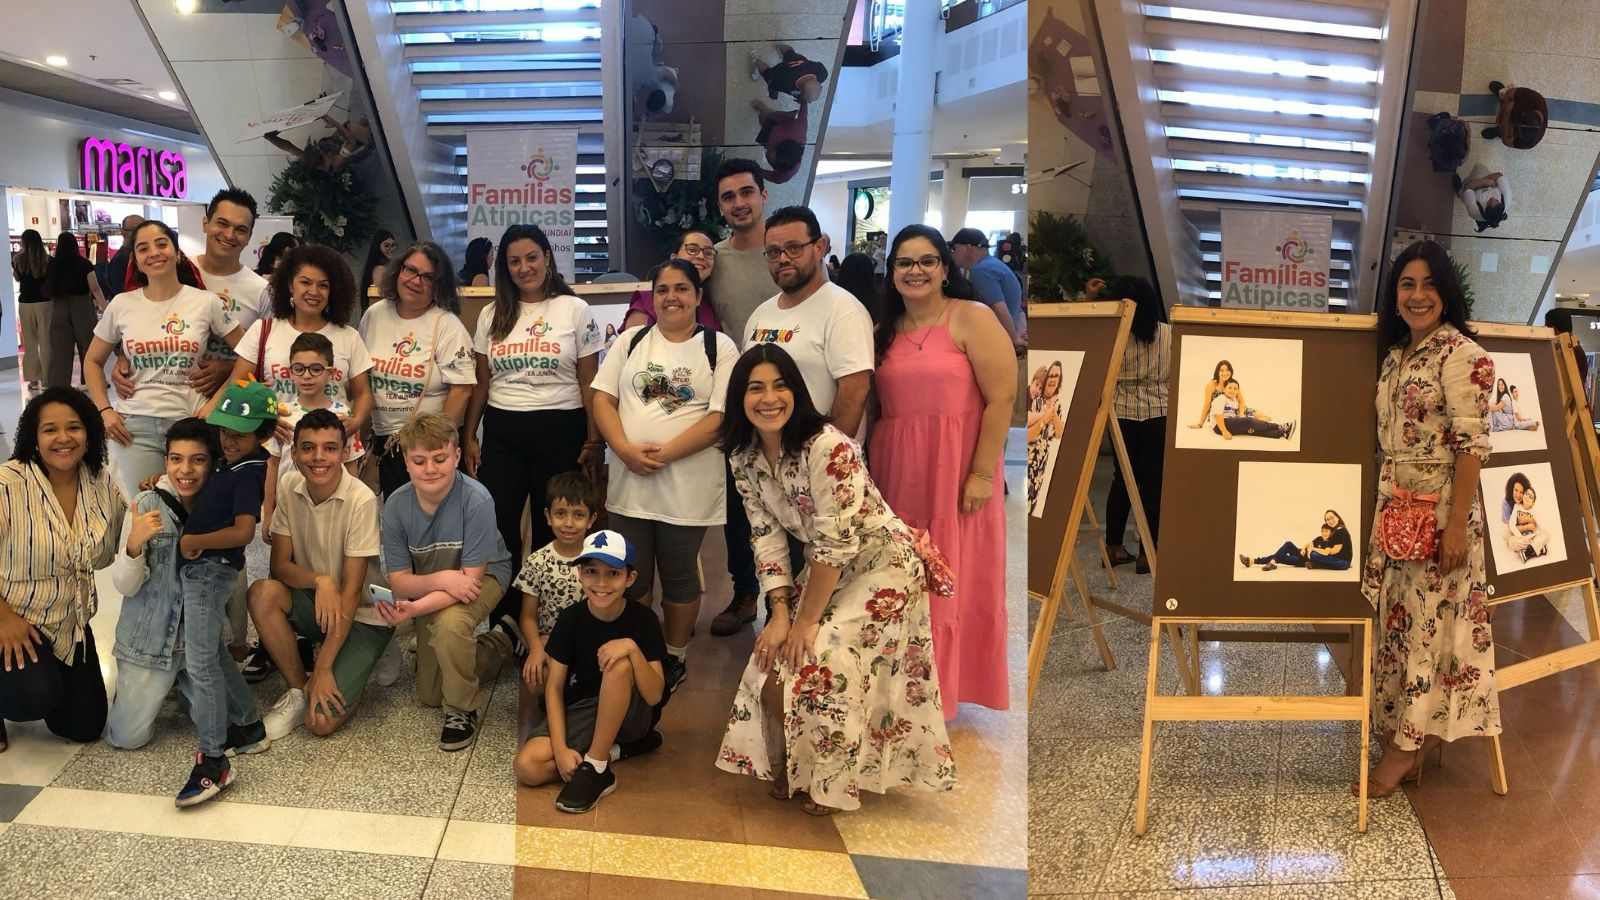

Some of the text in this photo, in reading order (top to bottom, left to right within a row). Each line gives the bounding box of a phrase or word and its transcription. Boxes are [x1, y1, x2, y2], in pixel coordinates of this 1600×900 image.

[81, 136, 188, 199] marisa
[472, 182, 572, 205] Famílias
[1225, 261, 1326, 288] Famílias
[1225, 282, 1326, 310] Atípicas
